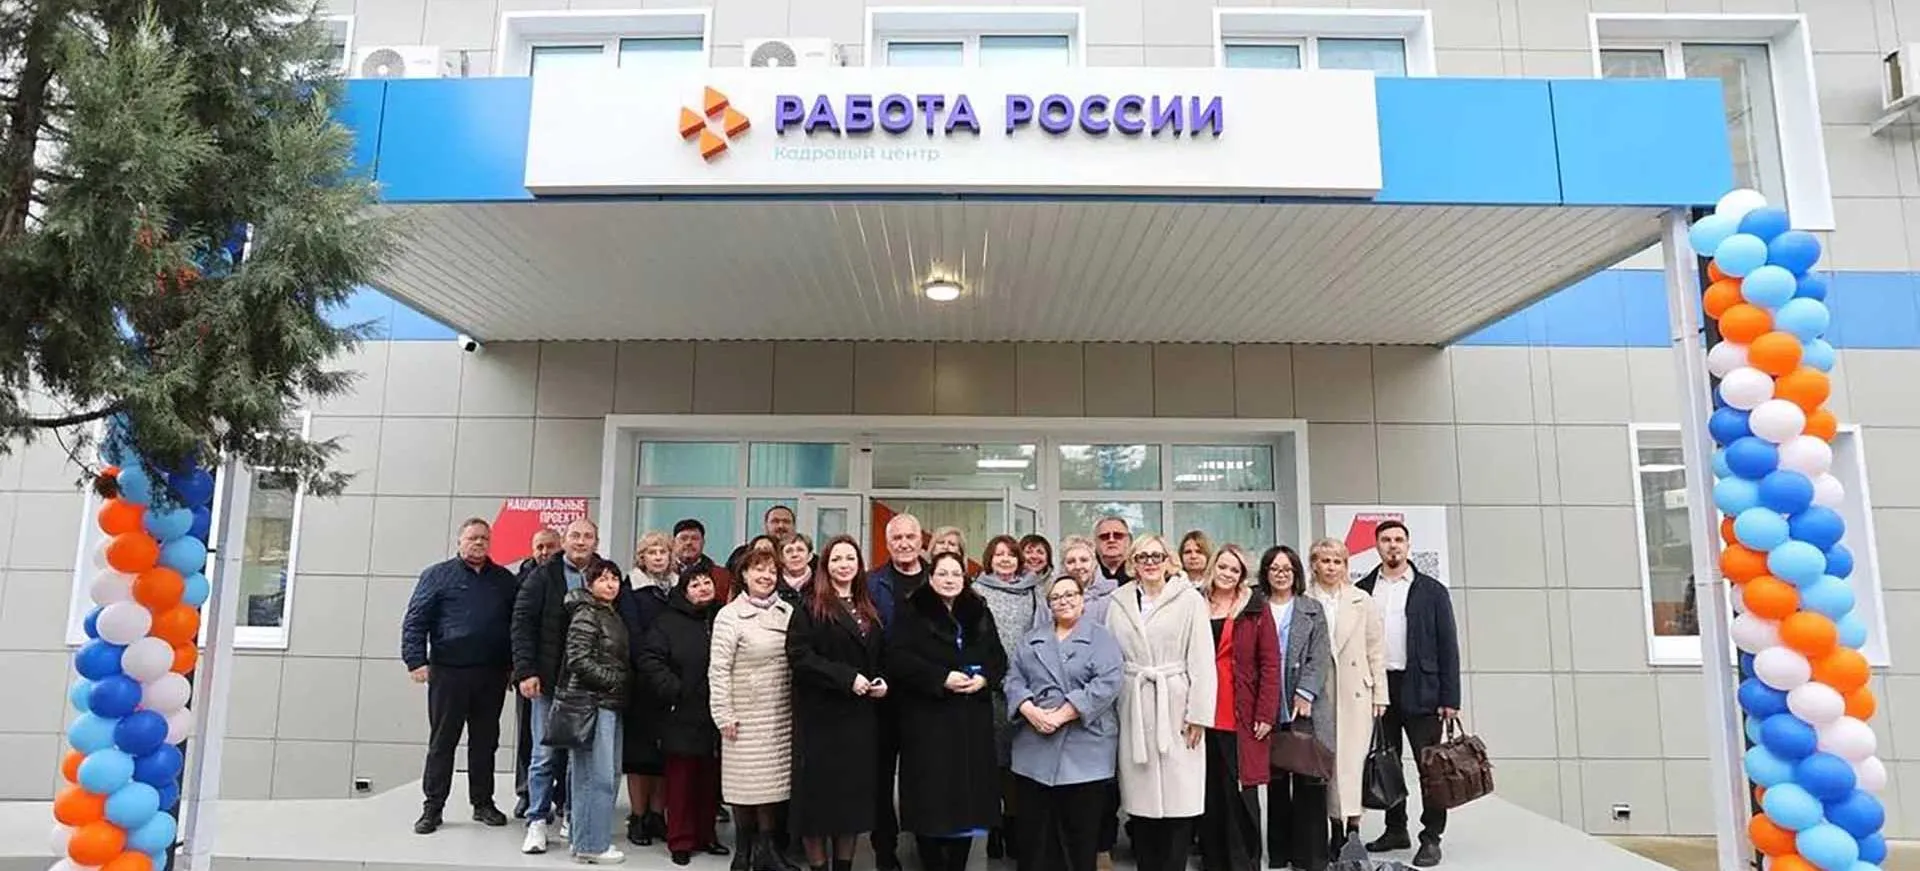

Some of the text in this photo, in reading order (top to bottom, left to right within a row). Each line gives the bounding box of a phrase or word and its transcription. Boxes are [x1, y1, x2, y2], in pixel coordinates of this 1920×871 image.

[775, 93, 1224, 136] РАБОТА РОССИИ
[774, 146, 941, 162] Кадровый центр
